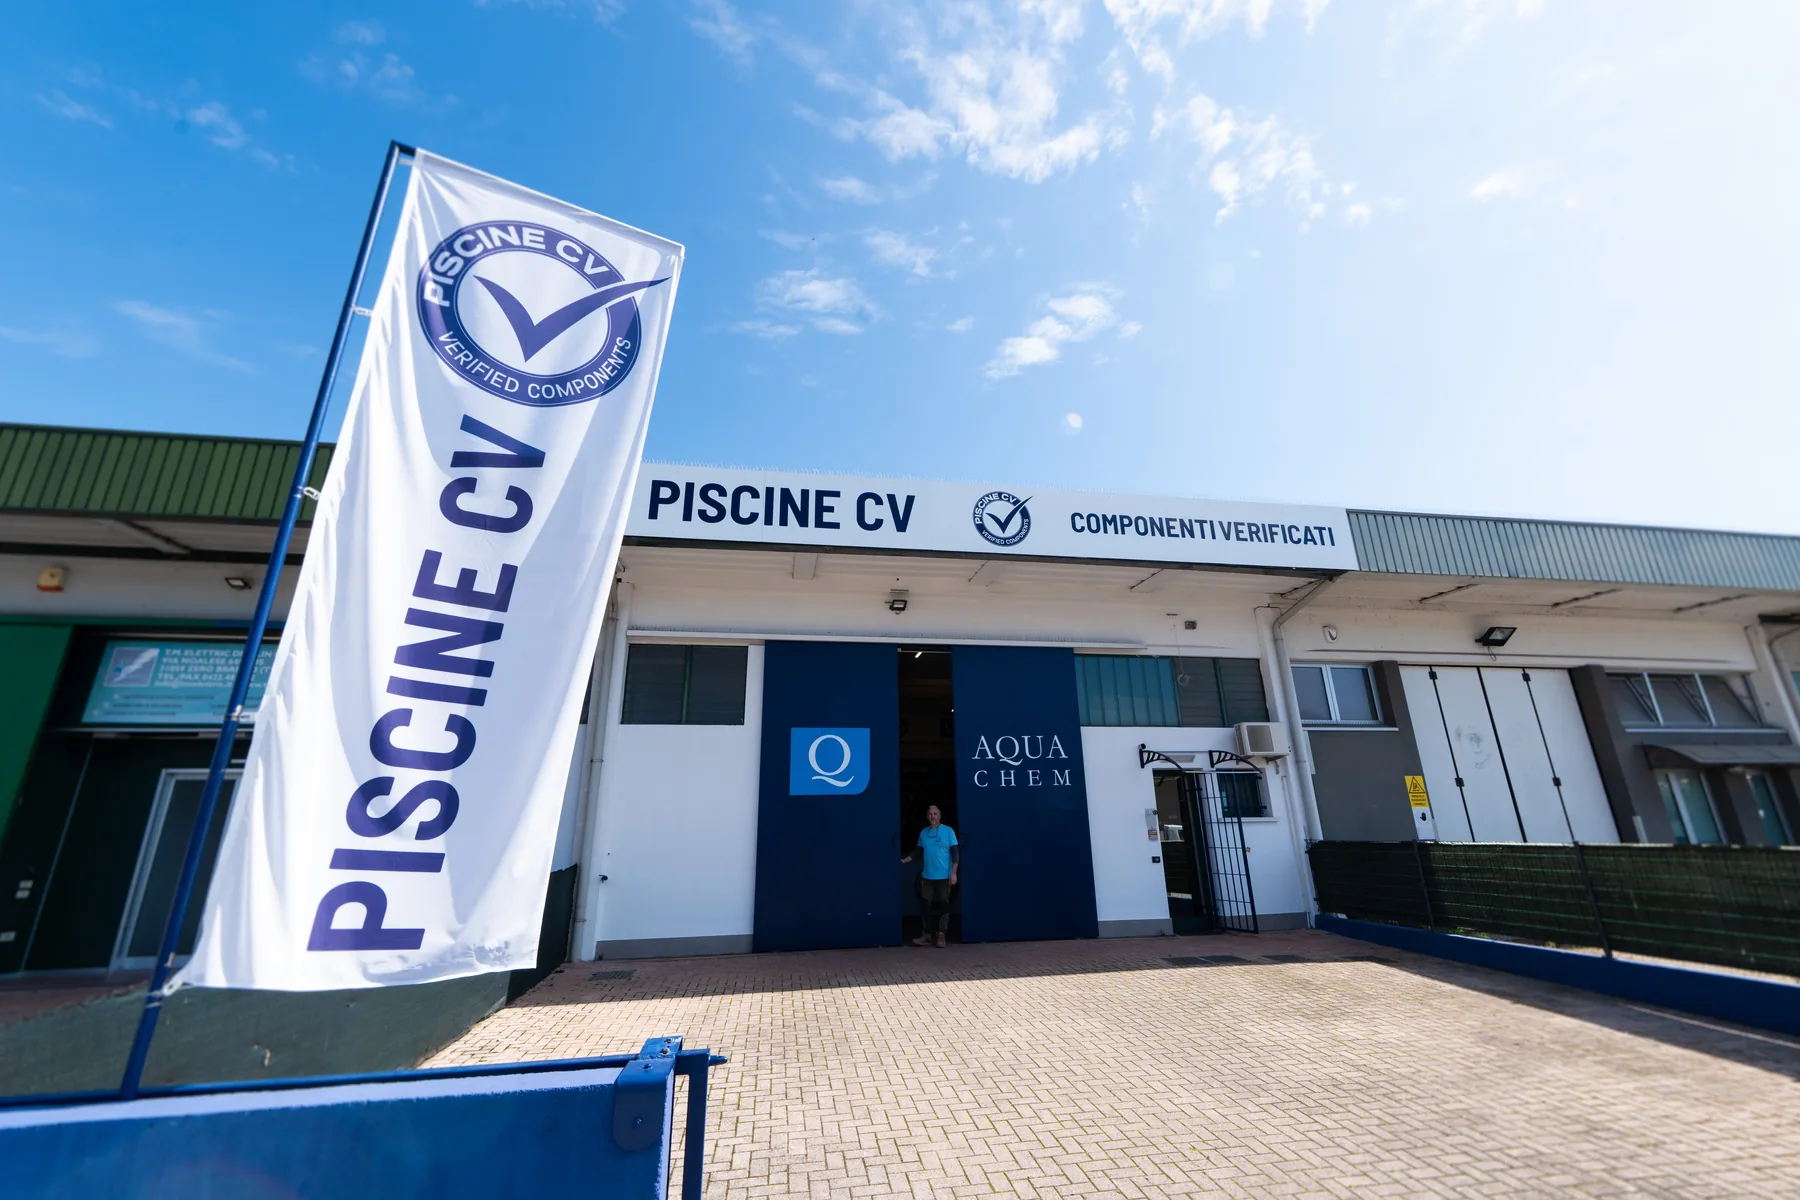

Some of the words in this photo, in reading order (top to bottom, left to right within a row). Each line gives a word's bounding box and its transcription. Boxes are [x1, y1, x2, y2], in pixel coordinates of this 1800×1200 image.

[424, 226, 546, 307] PISCINE
[556, 240, 609, 275] CV
[438, 331, 519, 393] VERIFIED
[527, 336, 632, 399] COMPONENTS
[648, 480, 841, 529] PISCINE
[856, 491, 916, 533] CV
[974, 493, 999, 524] PISCINE
[1001, 493, 1017, 503] CV
[982, 530, 1005, 544] VERIFIED
[1005, 518, 1029, 544] COMPONENTS
[1070, 512, 1216, 540] COMPONENTI
[1218, 521, 1336, 547] VERIFICATI
[181, 657, 225, 665] NOALESE
[184, 649, 229, 658] ELETTRIC
[188, 665, 213, 673] ZERO
[307, 549, 518, 951] PISCINE
[439, 414, 546, 533] CV
[808, 734, 855, 787] Q
[972, 734, 1069, 766] AQUA
[974, 769, 1072, 787] CHEM
